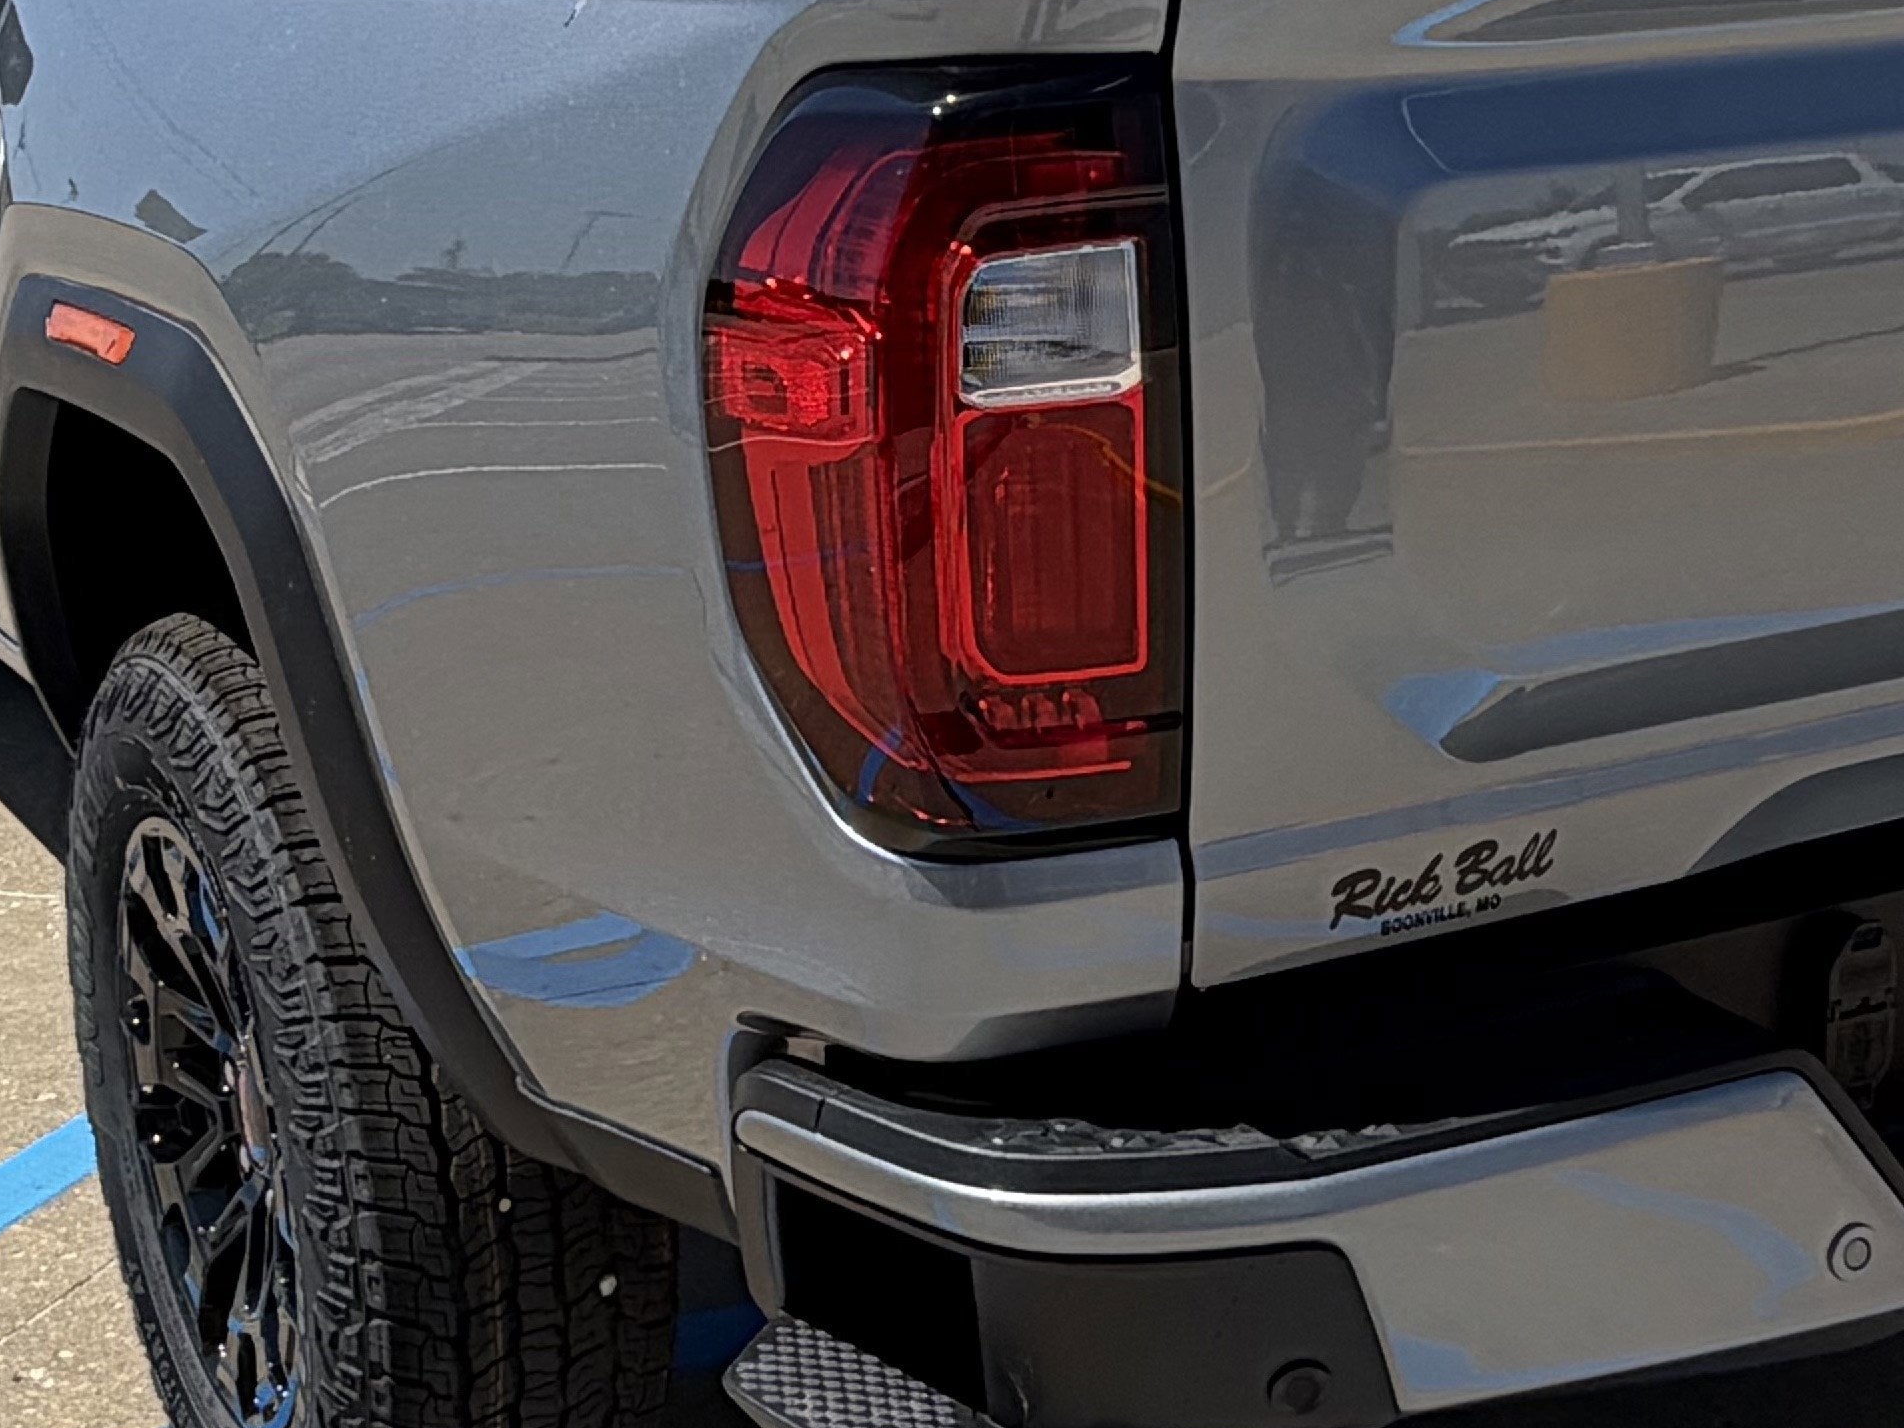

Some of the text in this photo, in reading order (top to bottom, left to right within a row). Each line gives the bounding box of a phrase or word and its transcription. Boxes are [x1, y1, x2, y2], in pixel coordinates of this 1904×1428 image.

[1330, 828, 1557, 930] Rick Ball
[1476, 893, 1502, 912] MO
